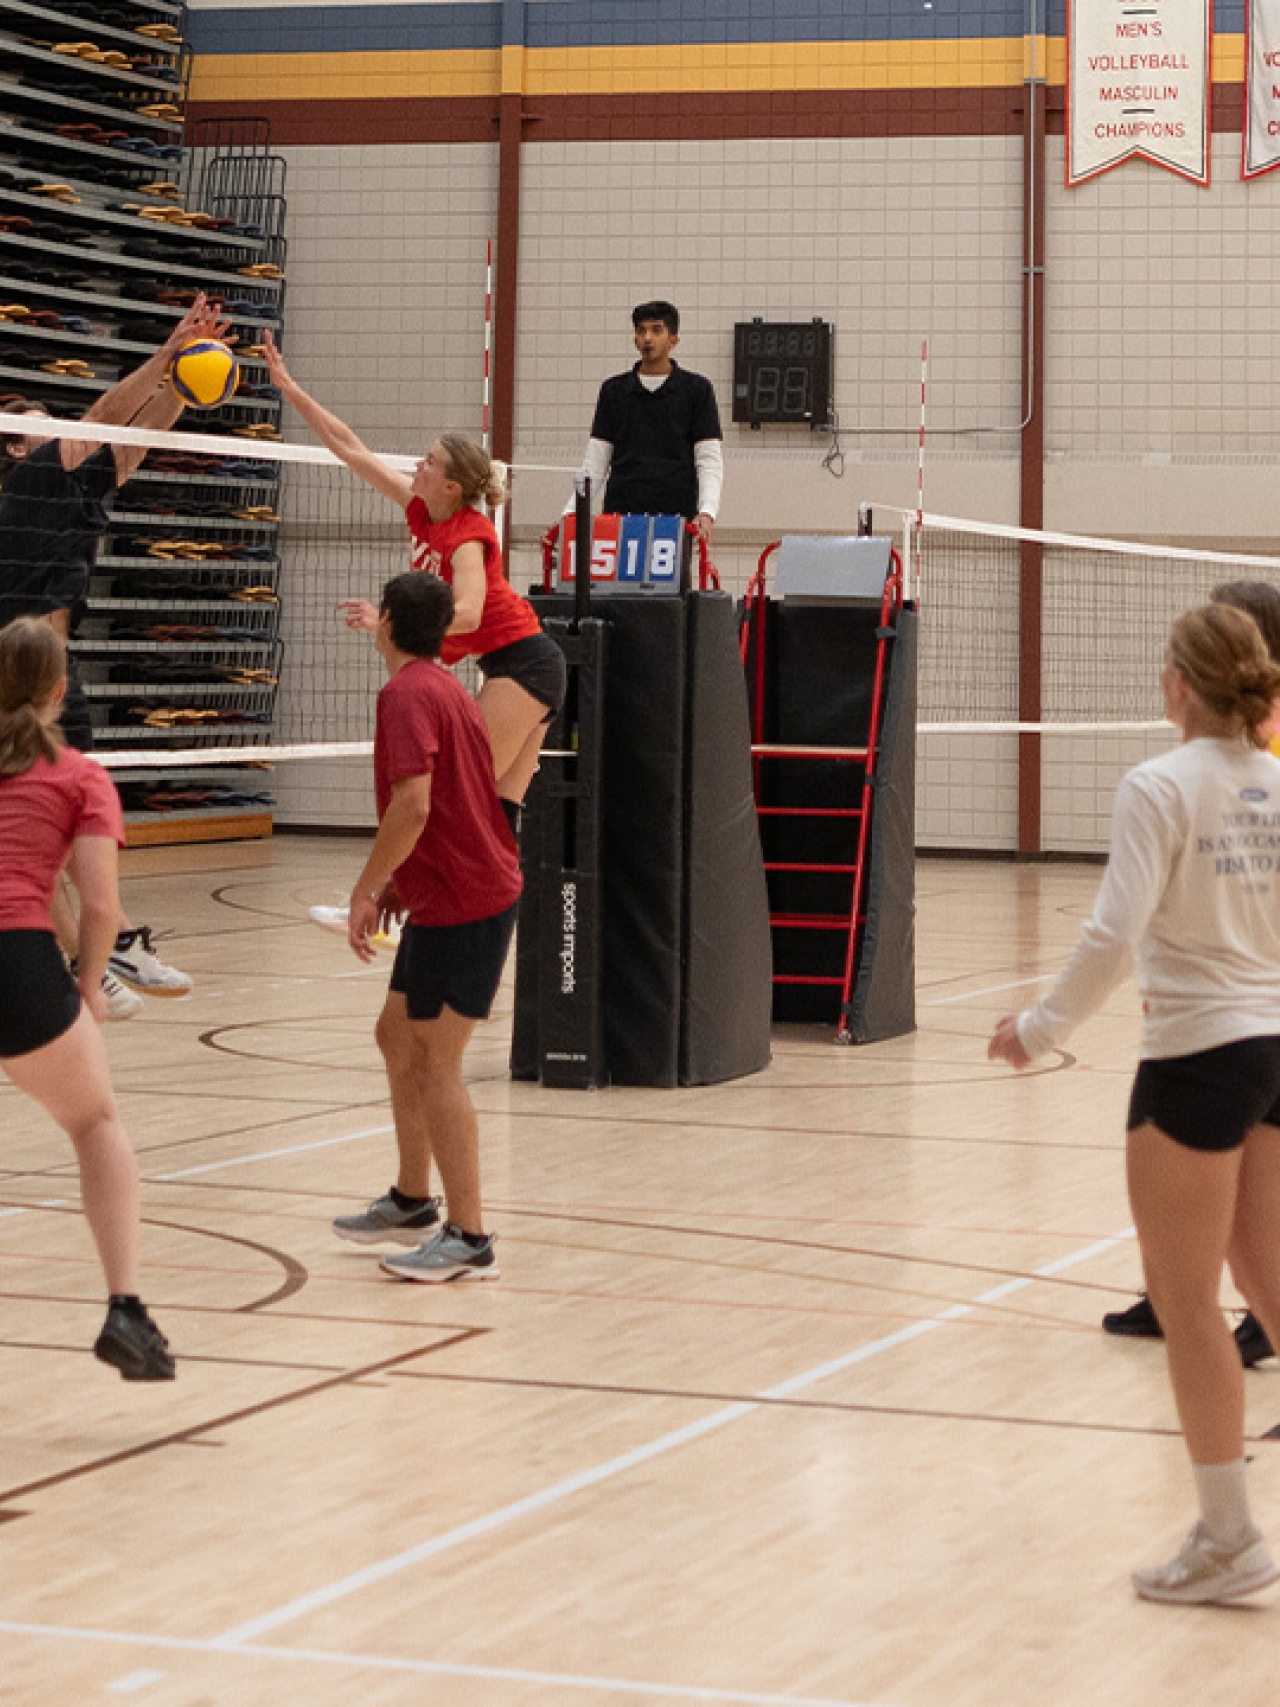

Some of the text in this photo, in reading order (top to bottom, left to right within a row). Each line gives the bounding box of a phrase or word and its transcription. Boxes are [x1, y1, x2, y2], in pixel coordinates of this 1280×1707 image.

[1115, 22, 1162, 38] MEN'S
[1088, 54, 1190, 71] VOLLEYBALL
[1099, 85, 1179, 101] MASCULIN
[1094, 121, 1186, 139] CHAMPIONS
[558, 882, 577, 994] sports imports
